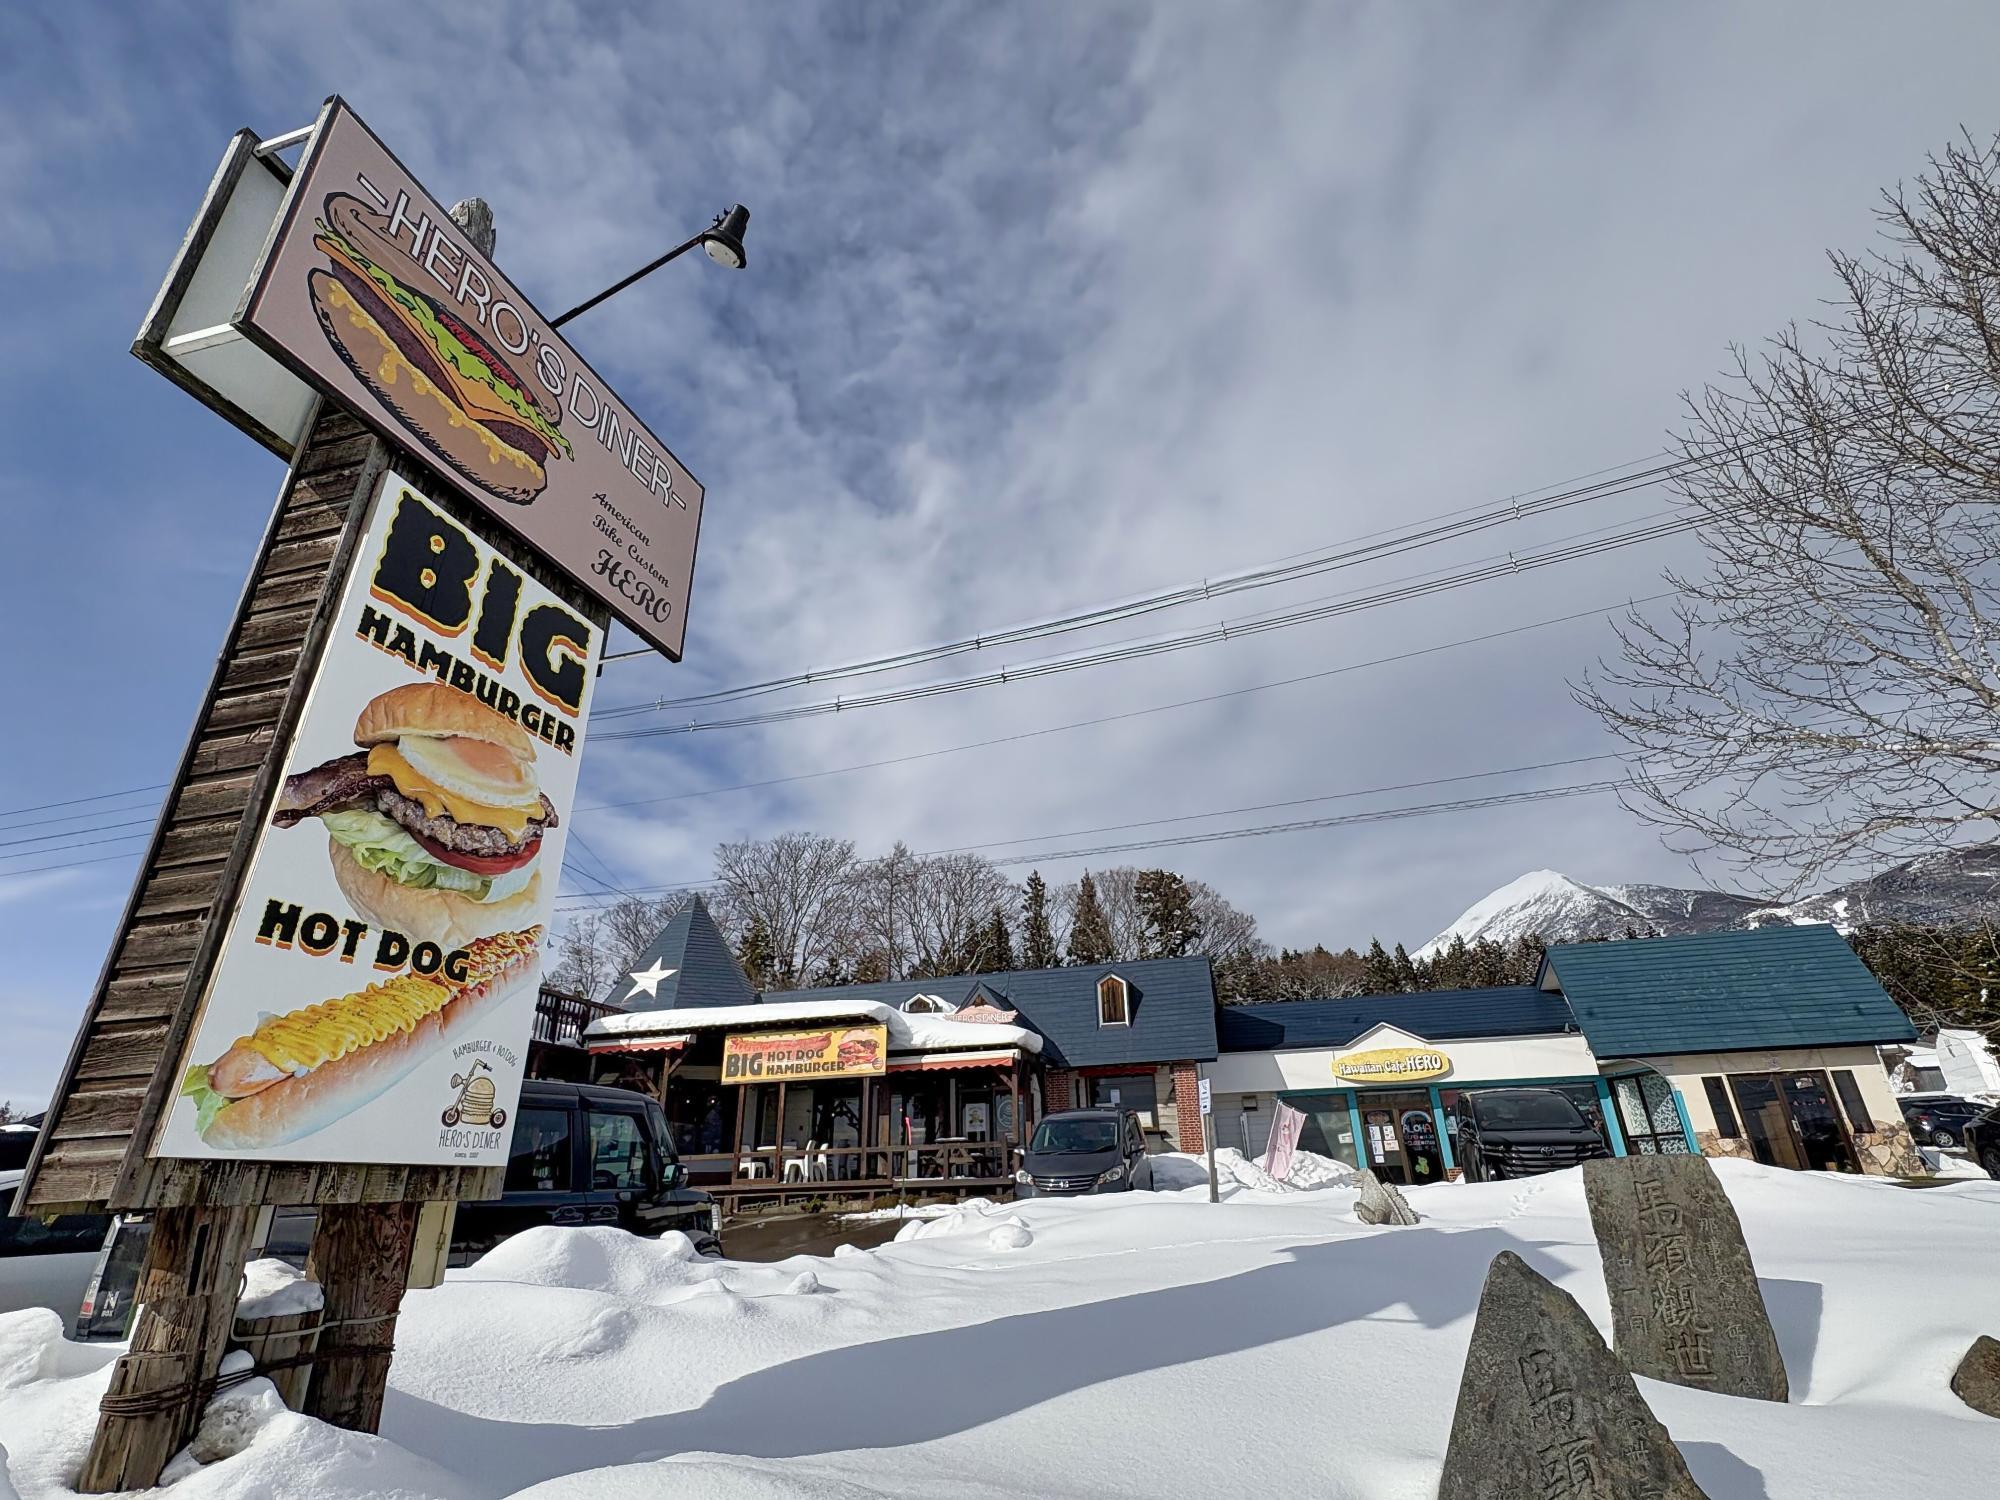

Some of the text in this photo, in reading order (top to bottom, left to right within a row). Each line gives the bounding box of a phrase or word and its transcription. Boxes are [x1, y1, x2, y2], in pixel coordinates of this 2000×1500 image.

[592, 492, 651, 547] American
[592, 514, 670, 588] Bike Custom
[371, 488, 595, 718] BIG
[590, 549, 672, 623] HERO
[355, 604, 575, 755] HAMBURGER
[255, 899, 472, 985] HOT DOG
[983, 1012, 1008, 1022] DINER
[452, 1039, 492, 1060] HAMBURGER
[725, 1049, 824, 1078] BIG HOT DOG
[766, 1061, 846, 1076] HAMBURGER
[1338, 1063, 1384, 1076] Hawaiian
[1405, 1054, 1442, 1071] HERO
[438, 1128, 501, 1149] HERO'S DINER
